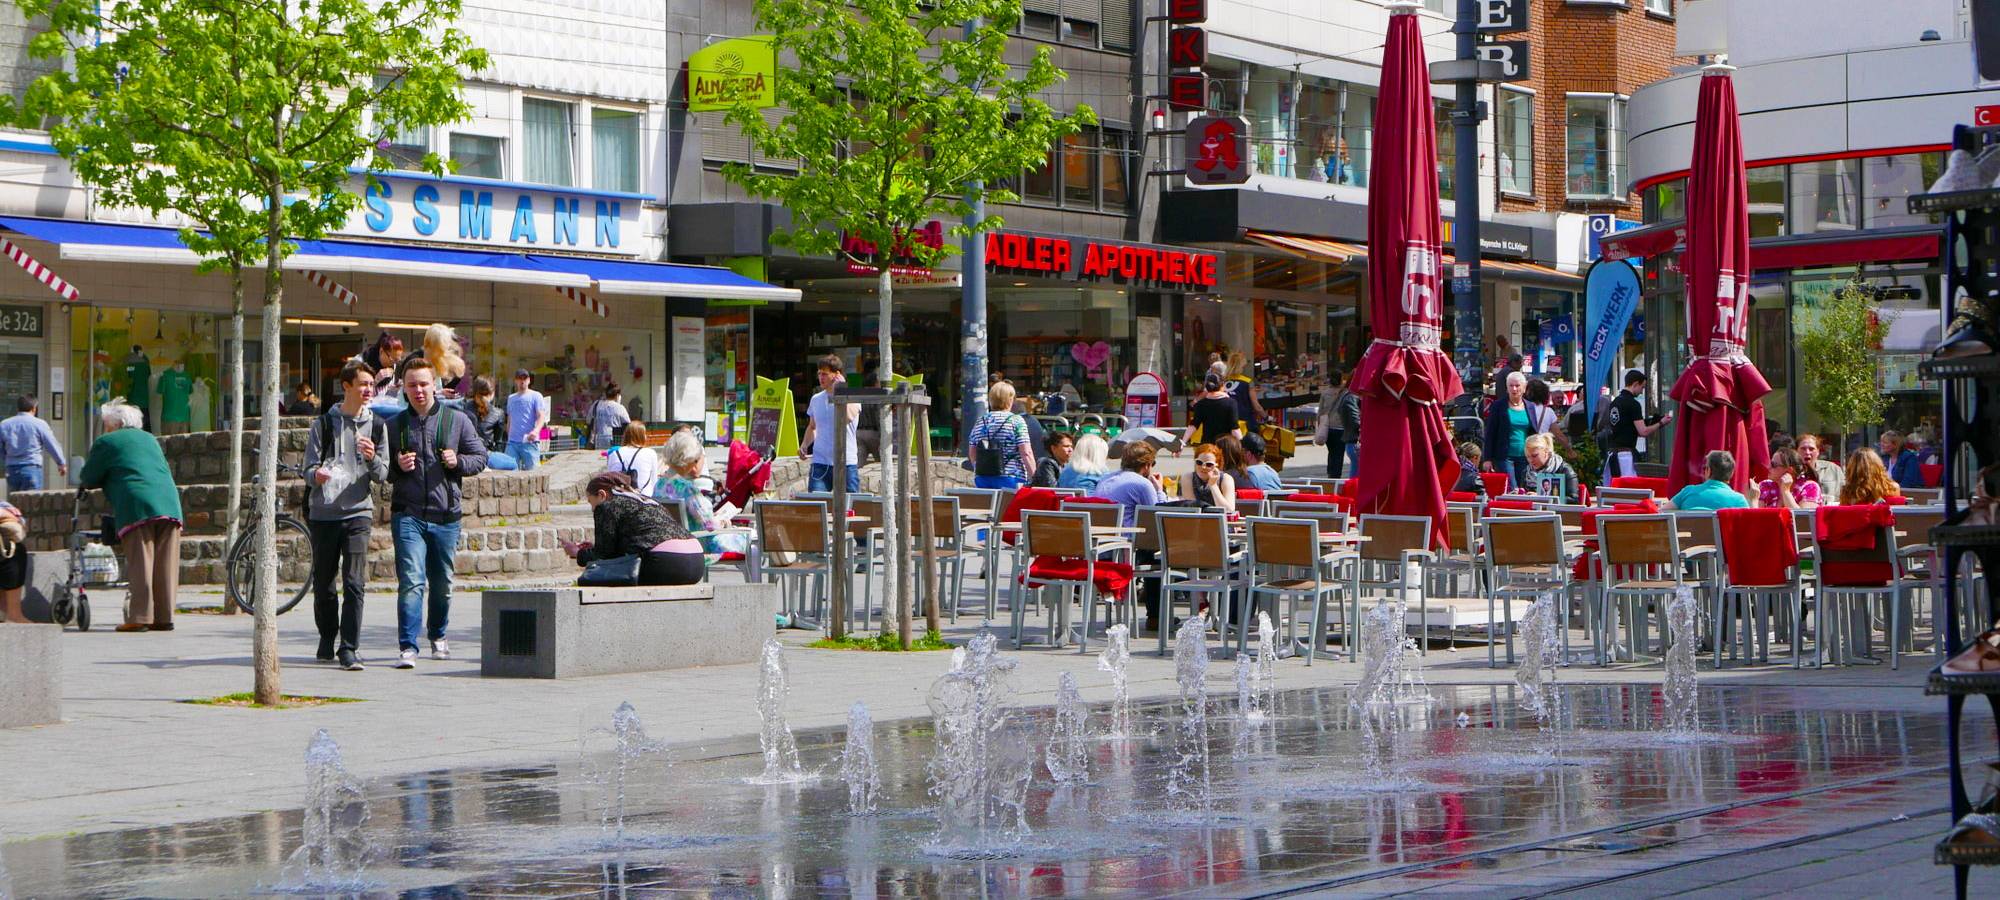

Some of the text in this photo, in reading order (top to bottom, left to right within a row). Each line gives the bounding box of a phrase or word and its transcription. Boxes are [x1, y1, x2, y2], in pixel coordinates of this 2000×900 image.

[695, 72, 765, 95] ALNURA
[264, 179, 621, 248] SSMANN
[984, 231, 1072, 273] ADLER
[1083, 242, 1218, 287] APOTHEKE
[0, 310, 37, 331] e 32a
[1588, 280, 1629, 361] backWERK
